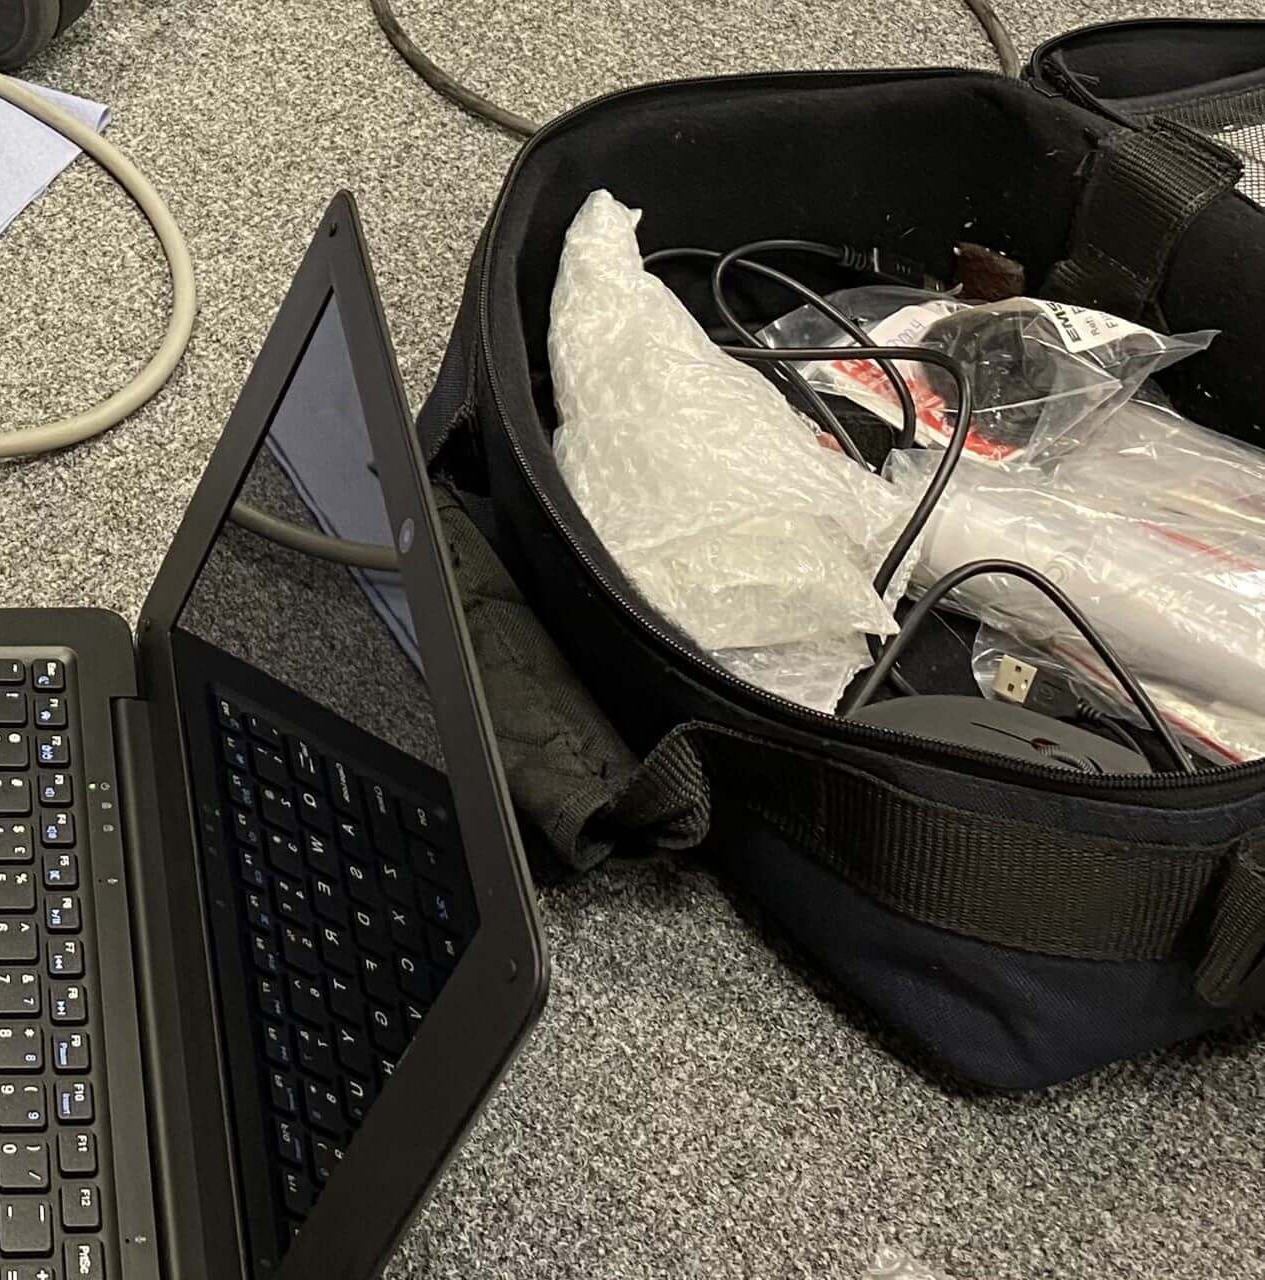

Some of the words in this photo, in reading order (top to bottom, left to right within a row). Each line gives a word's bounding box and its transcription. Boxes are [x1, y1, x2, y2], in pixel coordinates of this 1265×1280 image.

[1046, 302, 1081, 342] EMS
[60, 856, 69, 866] F5
[65, 942, 75, 953] F7
[0, 1029, 12, 1038] 8
[1, 1085, 14, 1094] 9
[74, 1084, 84, 1101] F10
[3, 1144, 16, 1154] 0
[78, 1135, 87, 1151] F11
[81, 1189, 90, 1206] F12
[79, 1246, 90, 1274] PrtSc
